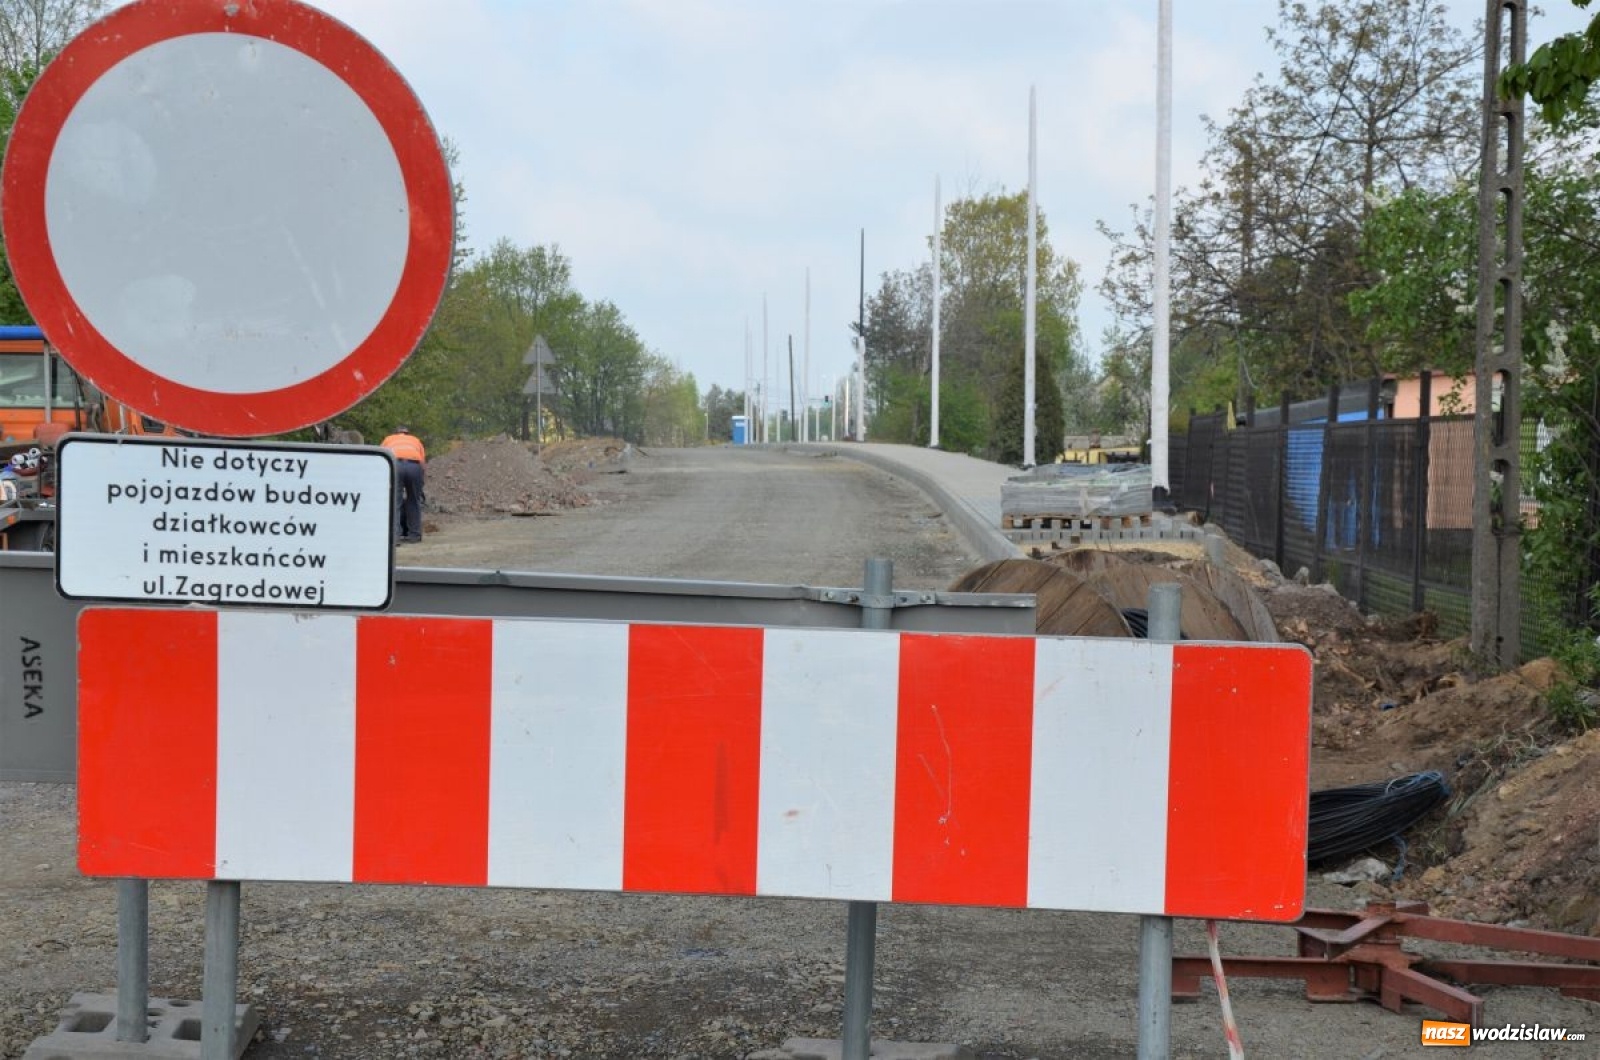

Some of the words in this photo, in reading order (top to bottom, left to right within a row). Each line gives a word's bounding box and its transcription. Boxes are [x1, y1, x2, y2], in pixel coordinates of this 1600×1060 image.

[161, 447, 204, 469] Nie
[213, 451, 309, 477] dotyczy
[107, 480, 256, 505] pojojazdów
[265, 484, 361, 512] budowy
[152, 512, 317, 537] działkowców
[143, 543, 149, 564] i
[159, 545, 326, 569] mieszkańców
[20, 636, 43, 719] ASEKA
